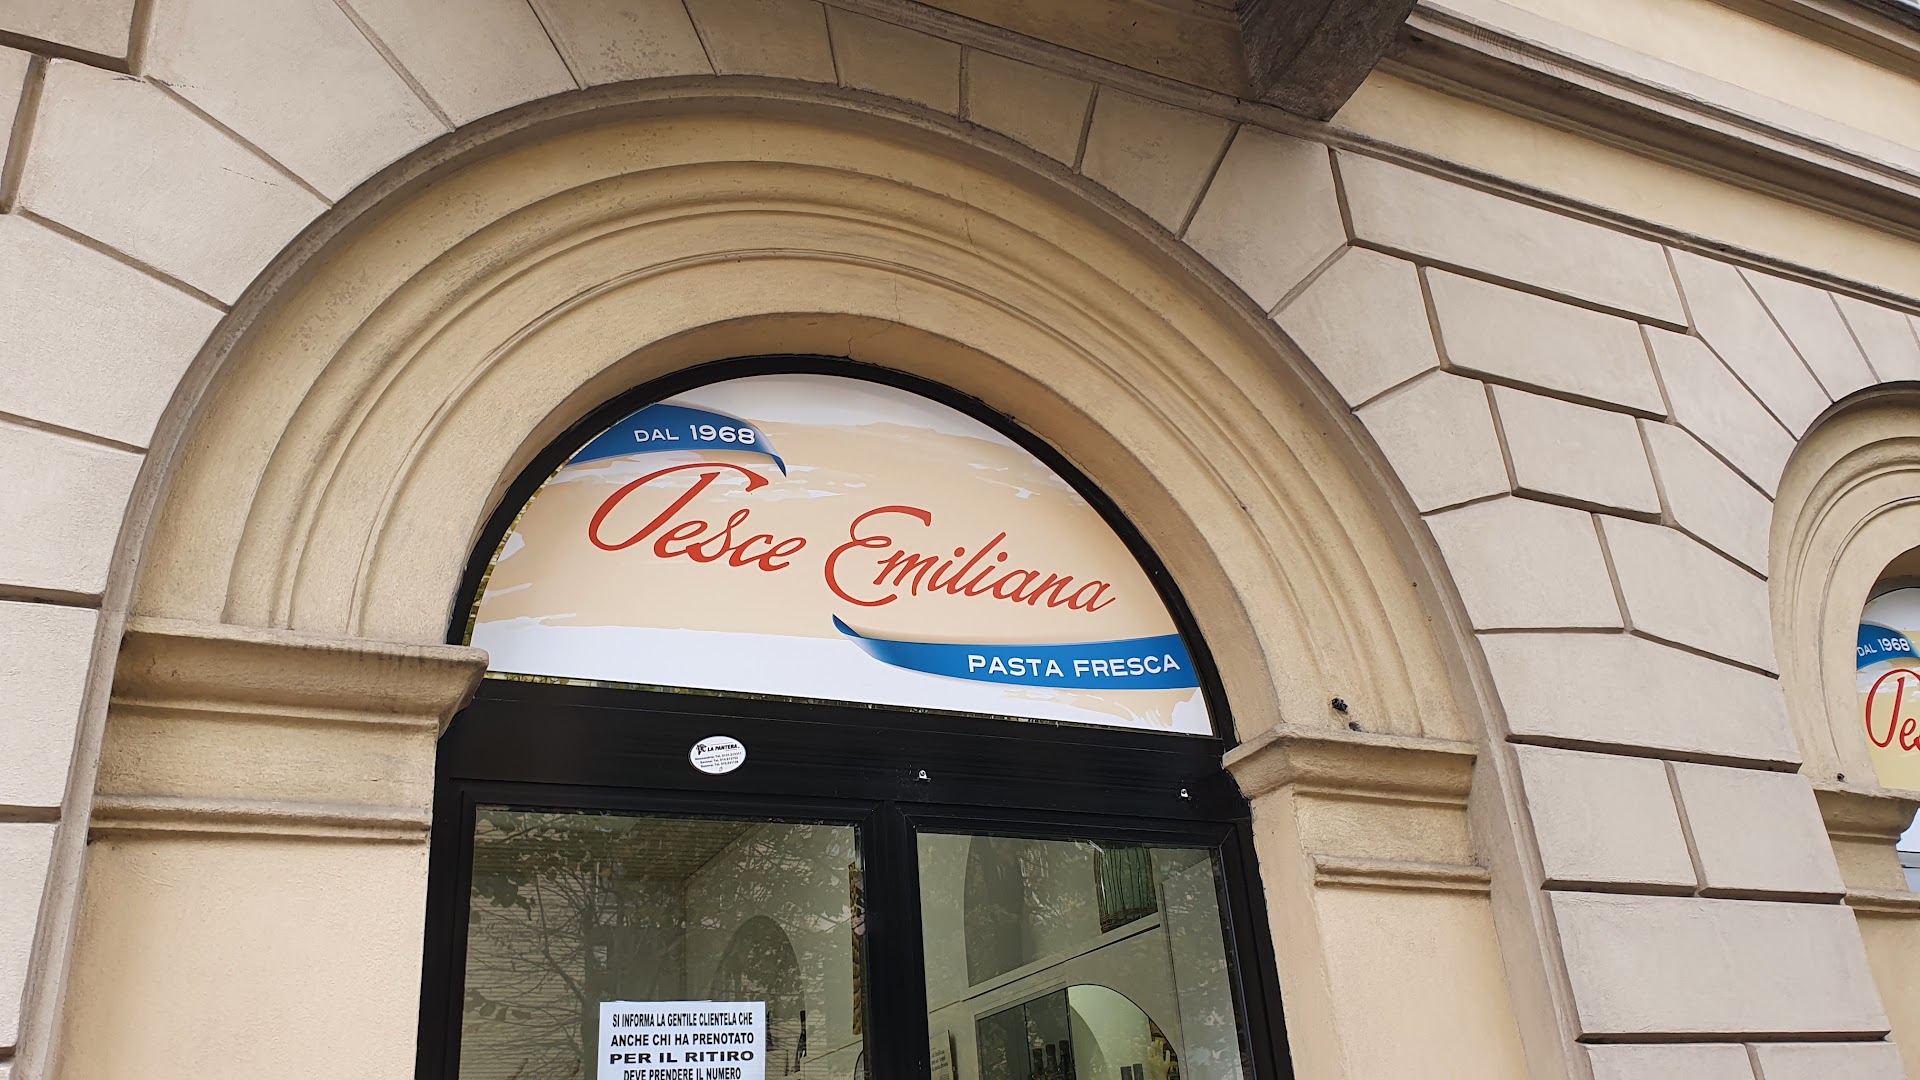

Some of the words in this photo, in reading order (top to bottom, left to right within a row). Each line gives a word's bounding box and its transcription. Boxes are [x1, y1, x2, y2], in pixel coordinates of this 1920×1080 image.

[633, 428, 680, 443] DAL
[689, 424, 756, 445] 1968
[588, 462, 807, 572] Pesce
[824, 505, 1116, 612] Emiliana
[1857, 643, 1878, 657] DAL
[1877, 637, 1911, 652] 1968
[967, 654, 1065, 677] PASTA
[1073, 654, 1181, 678] FRESCA
[1865, 668, 1920, 752] Pe
[612, 1013, 620, 1028] SI
[621, 1013, 655, 1027] INFORMA
[656, 1013, 666, 1027] LA
[667, 1012, 697, 1027] GENTILE
[699, 1012, 737, 1026] CLIENTELA
[738, 1011, 753, 1025] CHE
[610, 1033, 649, 1047] ANCHE
[652, 1033, 671, 1046] CHI
[675, 1033, 689, 1046] HA
[692, 1032, 754, 1045] PRENOTATO
[609, 1053, 652, 1064] PER
[659, 1052, 678, 1063] IL
[685, 1050, 754, 1063] RITIRO
[623, 1069, 646, 1080] DEVE
[649, 1068, 694, 1080] PRENDERE
[696, 1067, 704, 1080] IL
[706, 1066, 741, 1080] NUMERO
